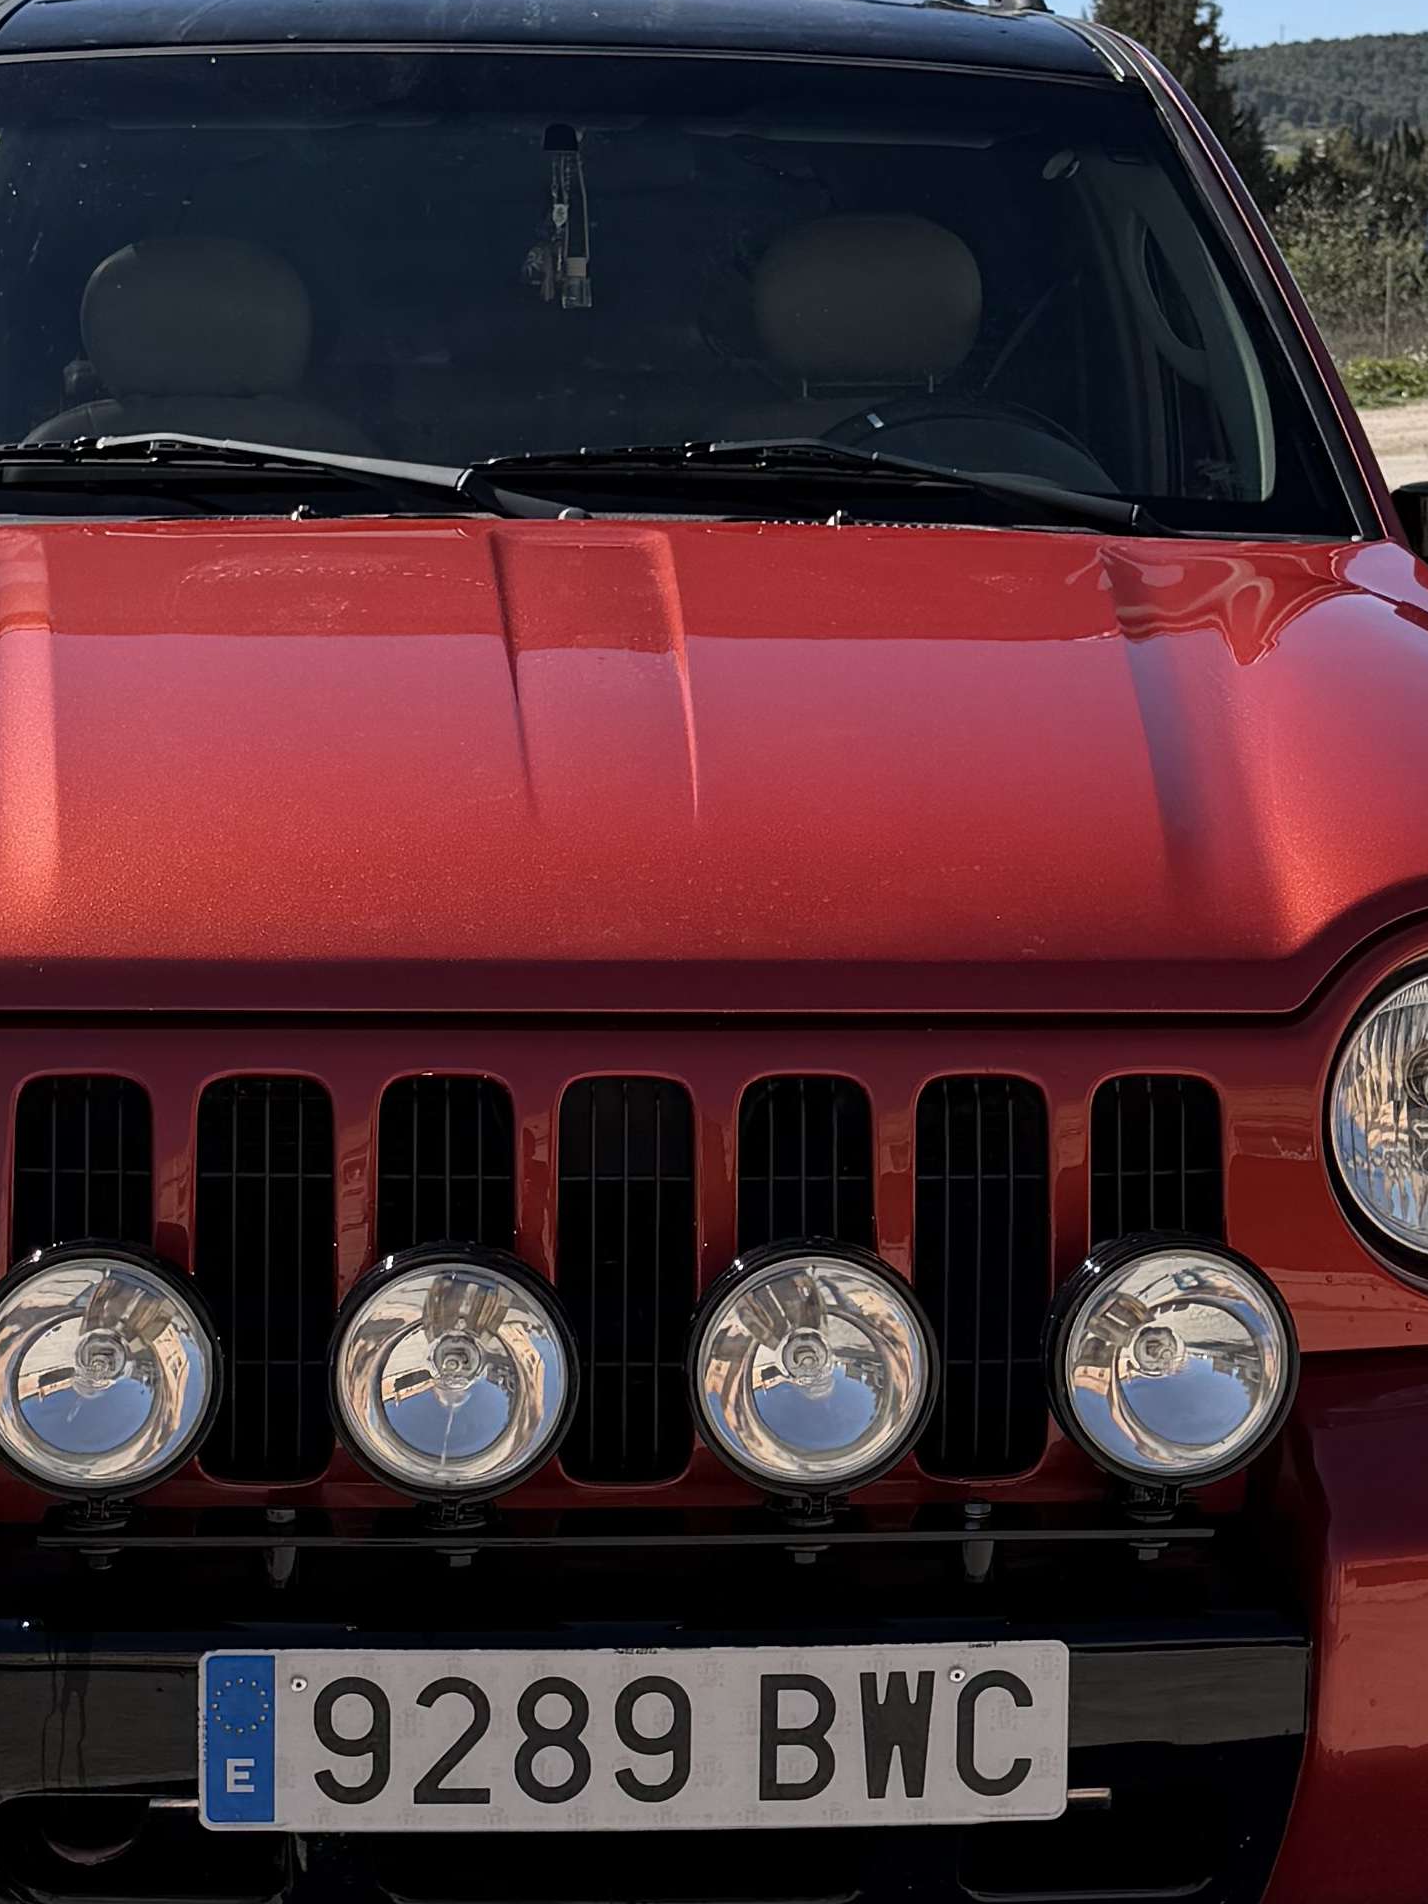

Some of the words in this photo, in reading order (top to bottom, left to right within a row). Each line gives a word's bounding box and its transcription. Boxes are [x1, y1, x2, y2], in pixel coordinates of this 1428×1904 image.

[226, 1758, 255, 1793] E
[314, 1676, 692, 1804] 9289
[759, 1670, 1033, 1801] BWC
